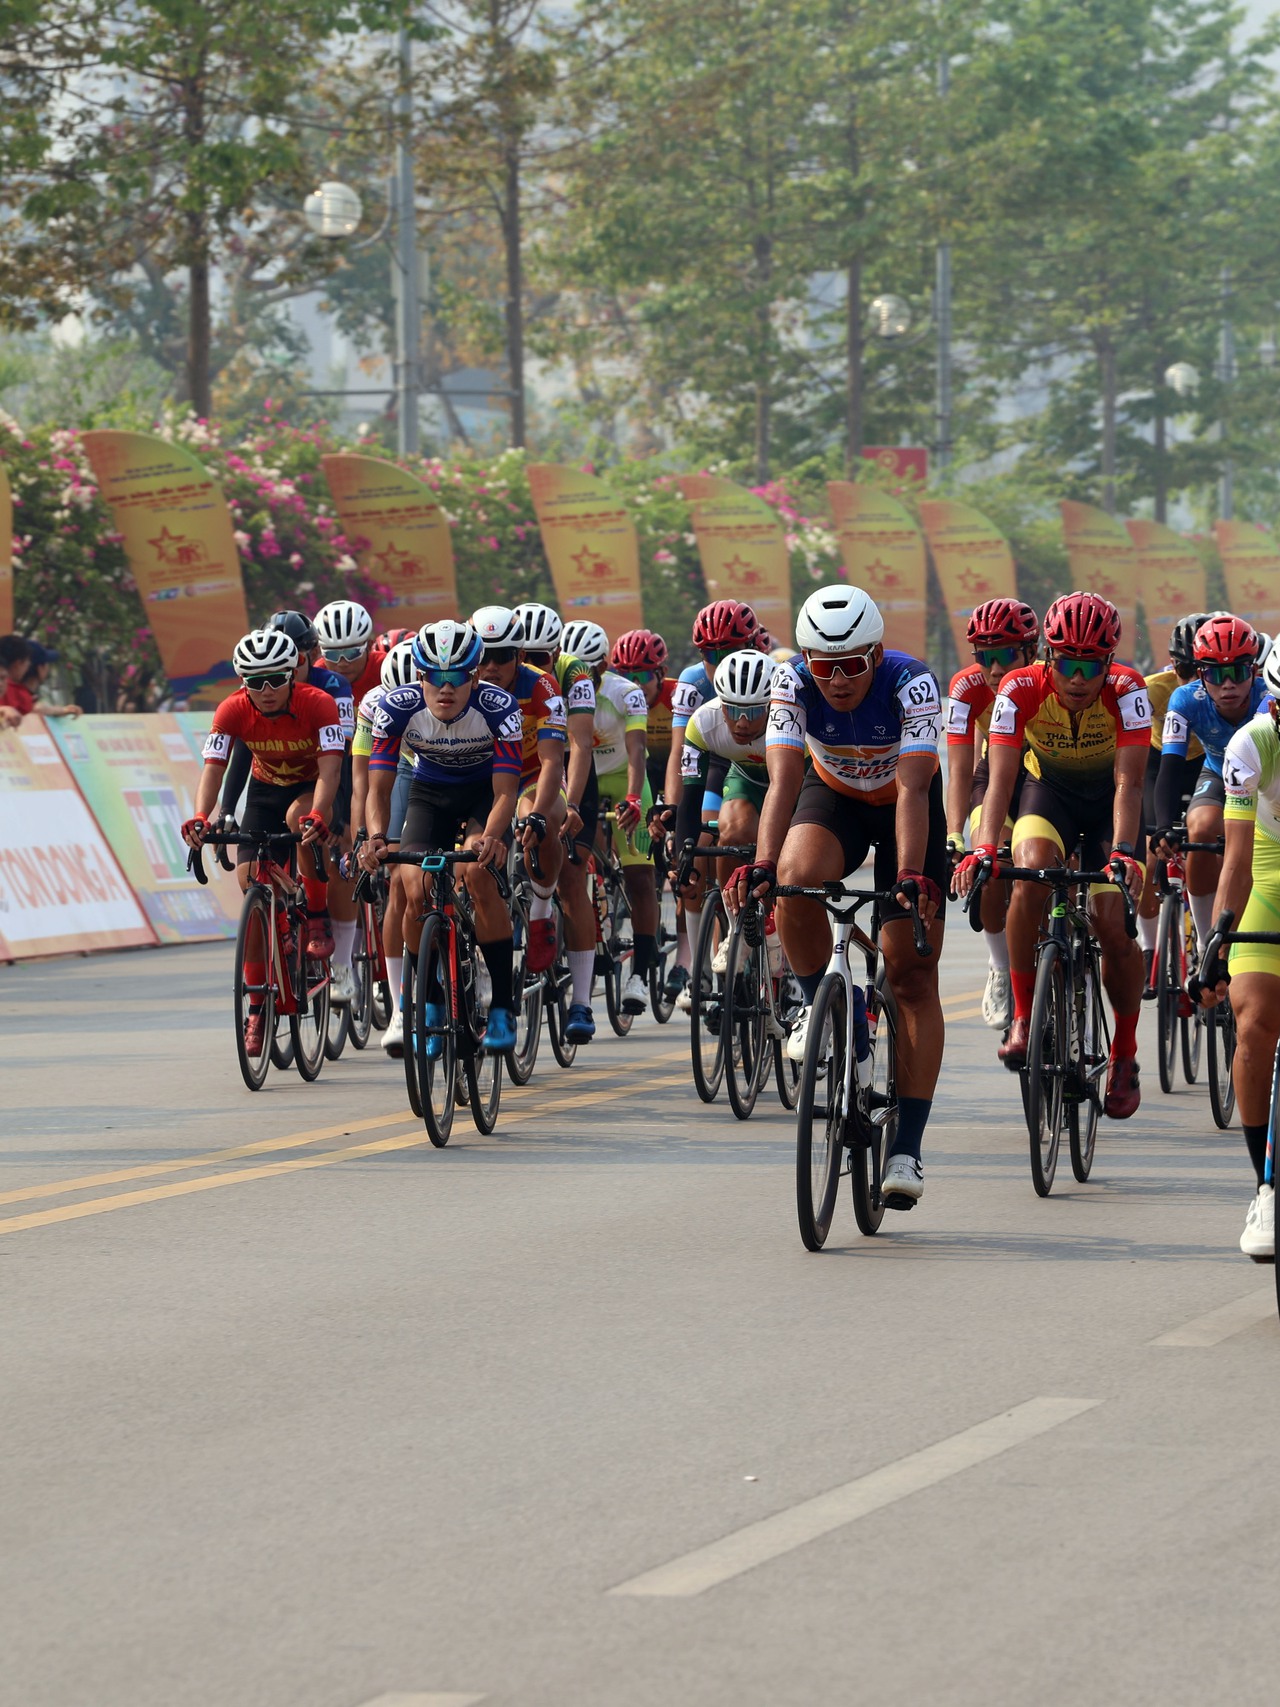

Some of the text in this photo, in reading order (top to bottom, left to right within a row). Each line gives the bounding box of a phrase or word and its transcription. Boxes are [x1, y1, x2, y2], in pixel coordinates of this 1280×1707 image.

[573, 684, 592, 700] 35
[678, 689, 698, 708] 16
[908, 681, 935, 705] 62
[338, 702, 353, 719] 66
[995, 701, 1004, 722] 6
[1134, 696, 1146, 718] 6
[205, 734, 225, 751] 96
[325, 726, 344, 743] 96
[1039, 869, 1045, 878] 3
